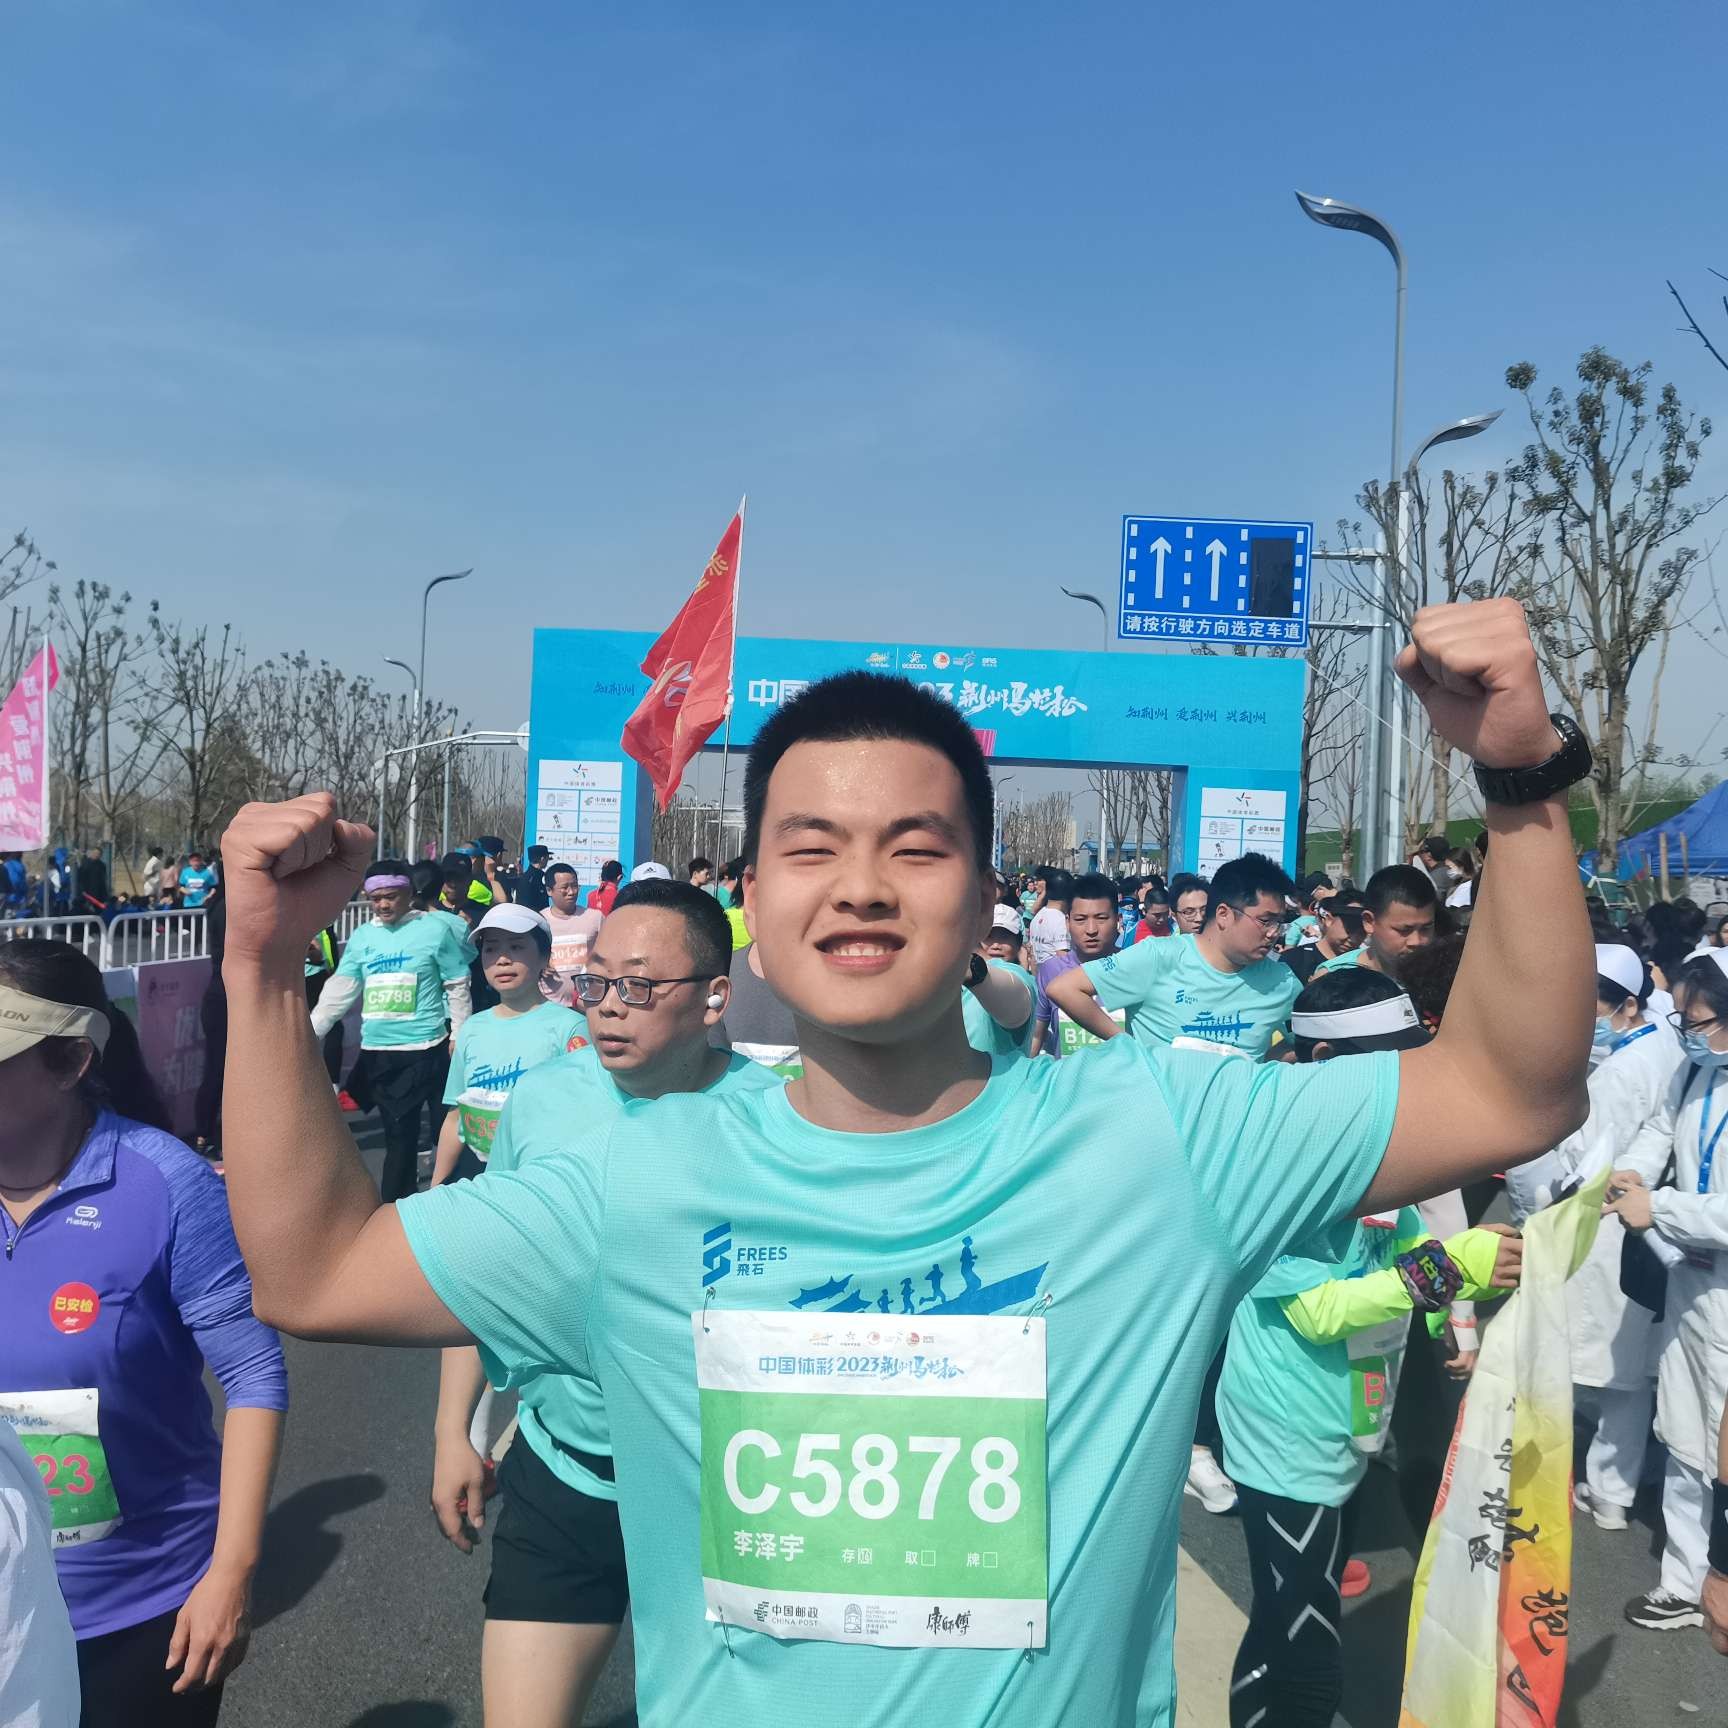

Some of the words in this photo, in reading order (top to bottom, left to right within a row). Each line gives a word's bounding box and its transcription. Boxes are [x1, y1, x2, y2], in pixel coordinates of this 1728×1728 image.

[1126, 615, 1300, 639] 请按行驶方向选定车道
[1125, 705, 1168, 720] 知荆州
[1175, 706, 1217, 722] 爱荆州
[1226, 709, 1267, 724] 兴荆州
[737, 1246, 788, 1261] FREES
[737, 1263, 765, 1276] 飛石
[54, 1296, 94, 1313] 已安检
[723, 1429, 1022, 1523] C5878
[733, 1529, 804, 1562] 李泽宇
[904, 1551, 918, 1567] 取
[966, 1552, 981, 1567] 牌
[772, 1604, 818, 1618] 中国邮政
[772, 1617, 795, 1625] CHINA
[798, 1619, 818, 1627] POST
